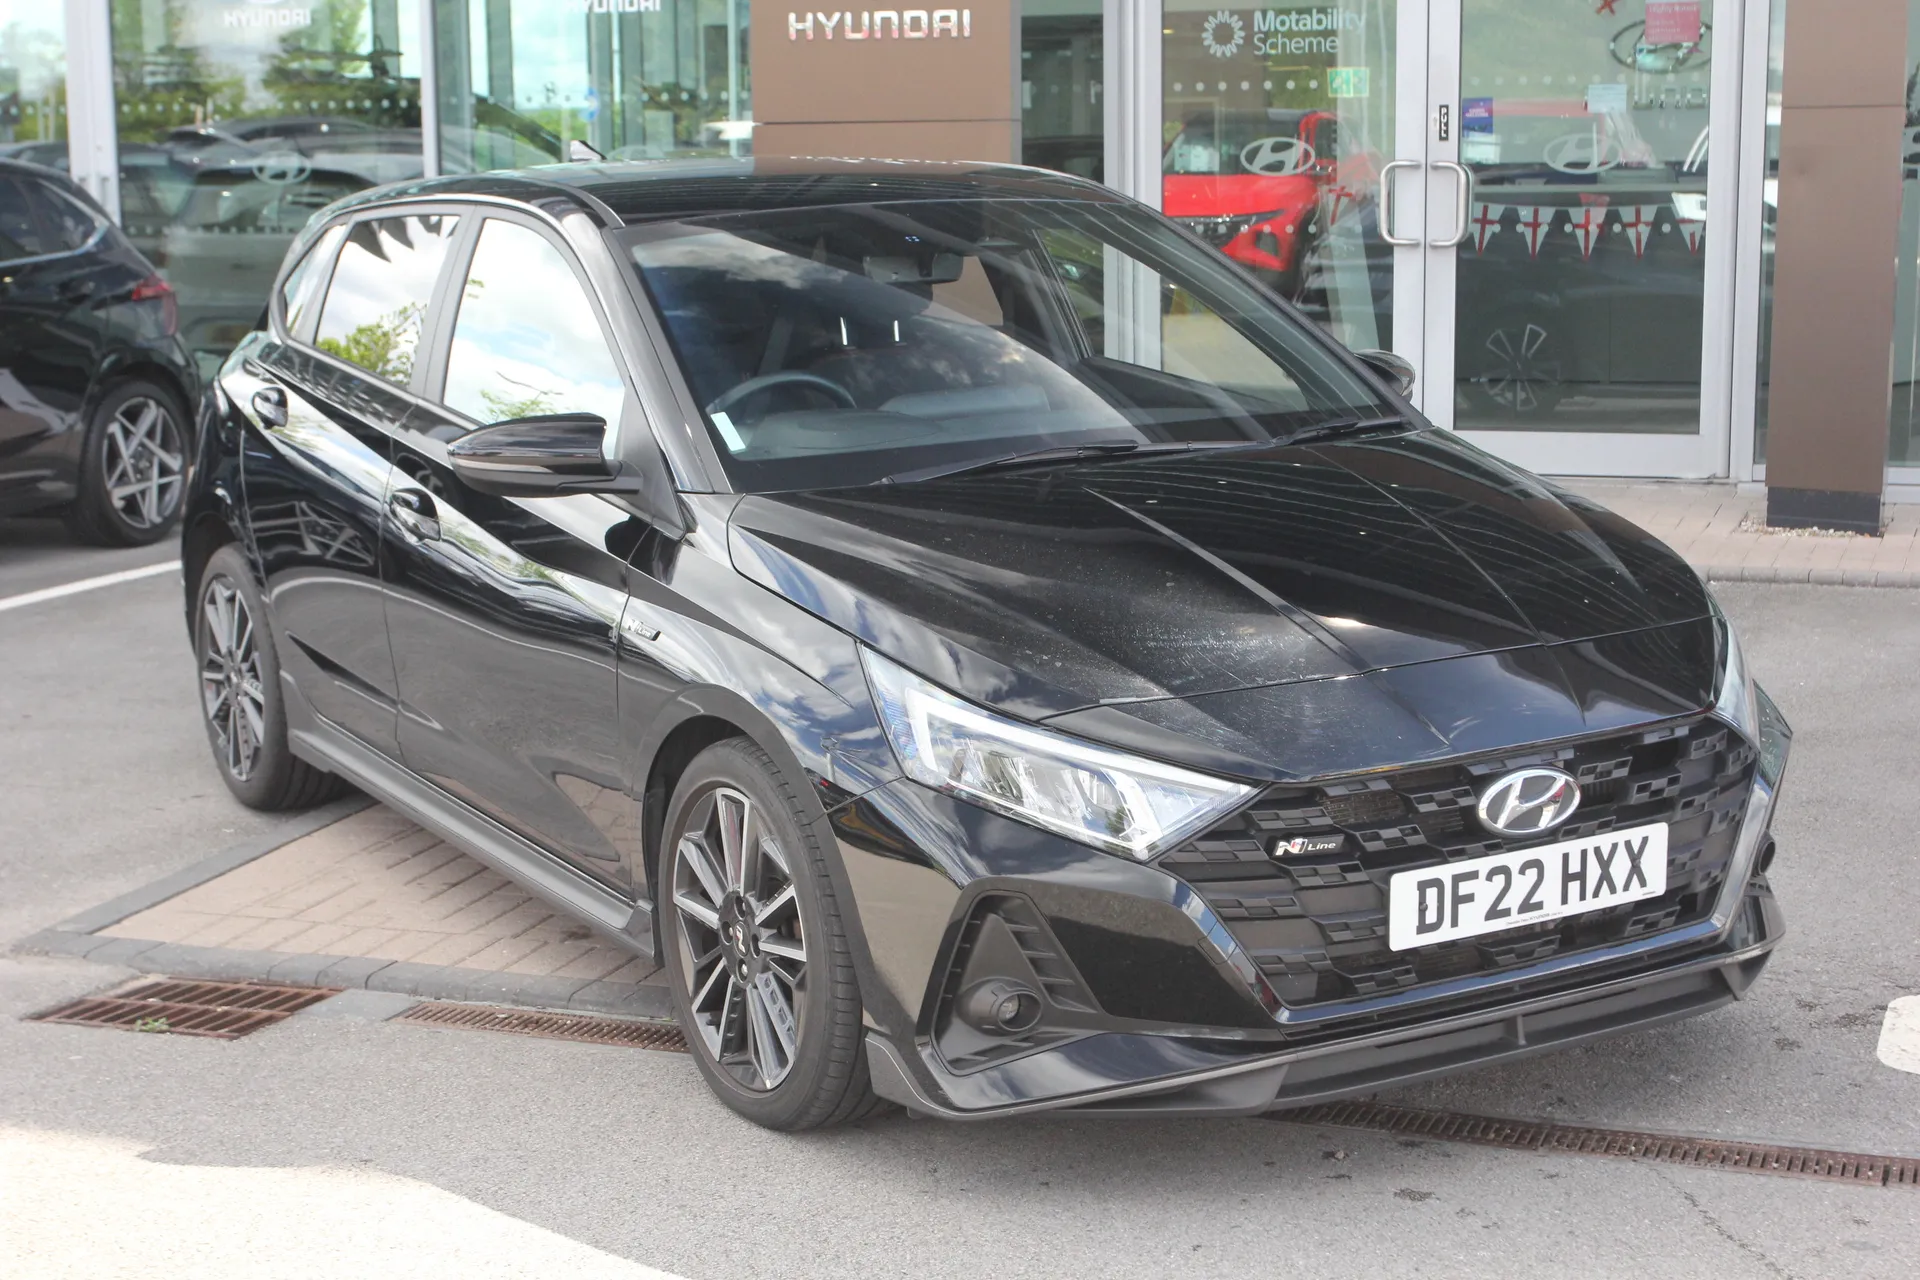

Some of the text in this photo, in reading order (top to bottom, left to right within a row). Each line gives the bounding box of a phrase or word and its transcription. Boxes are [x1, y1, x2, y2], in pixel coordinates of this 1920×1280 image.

[788, 9, 971, 41] HYUNDAI
[1253, 8, 1366, 34] Motability
[1253, 33, 1340, 55] Scheme
[1307, 842, 1337, 851] Line
[1416, 836, 1649, 935] DF22 HXX
